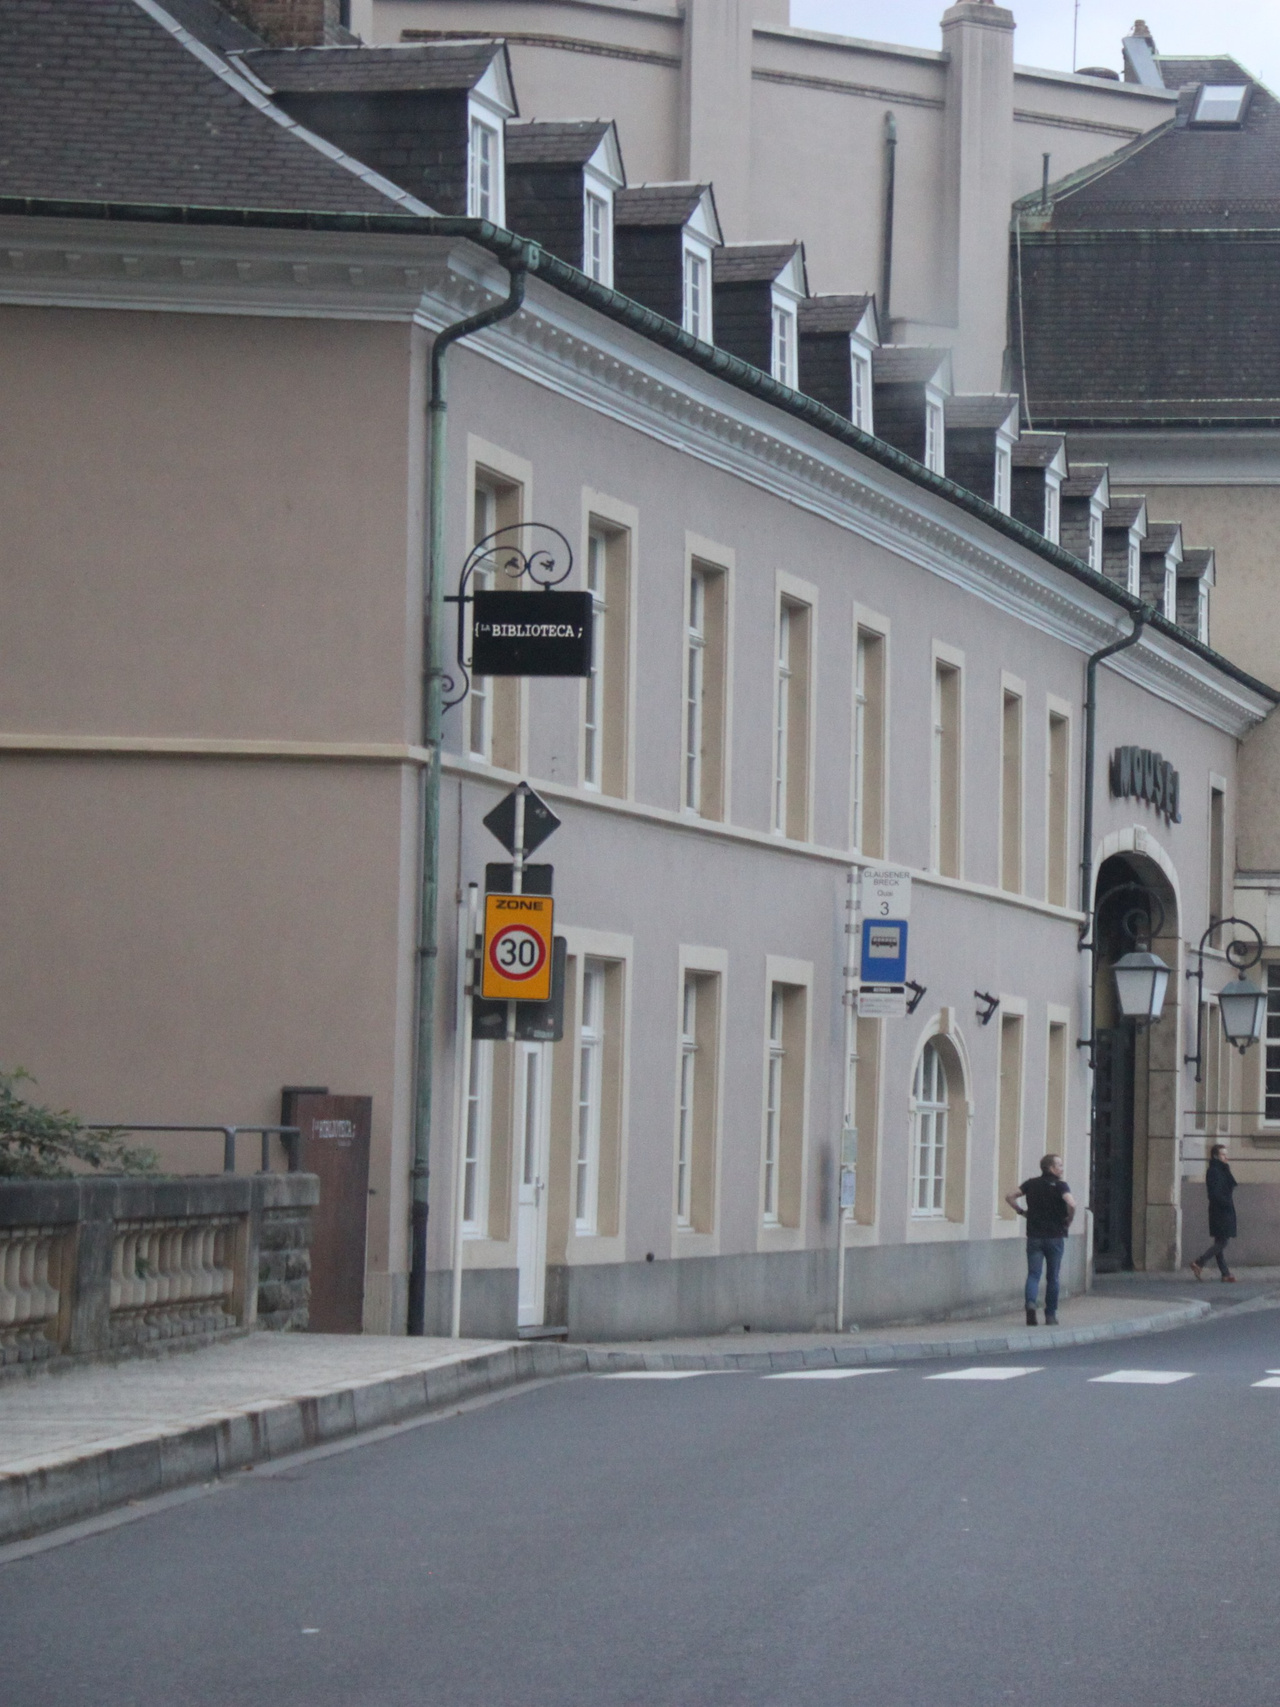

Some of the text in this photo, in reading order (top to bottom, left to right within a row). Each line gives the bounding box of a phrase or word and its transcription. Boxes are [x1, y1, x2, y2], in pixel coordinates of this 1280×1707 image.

[1110, 745, 1182, 825] MOUSEL
[864, 871, 910, 879] CLAUSENER
[496, 900, 543, 911] ZONE
[880, 901, 889, 916] 3
[500, 938, 535, 966] 30
